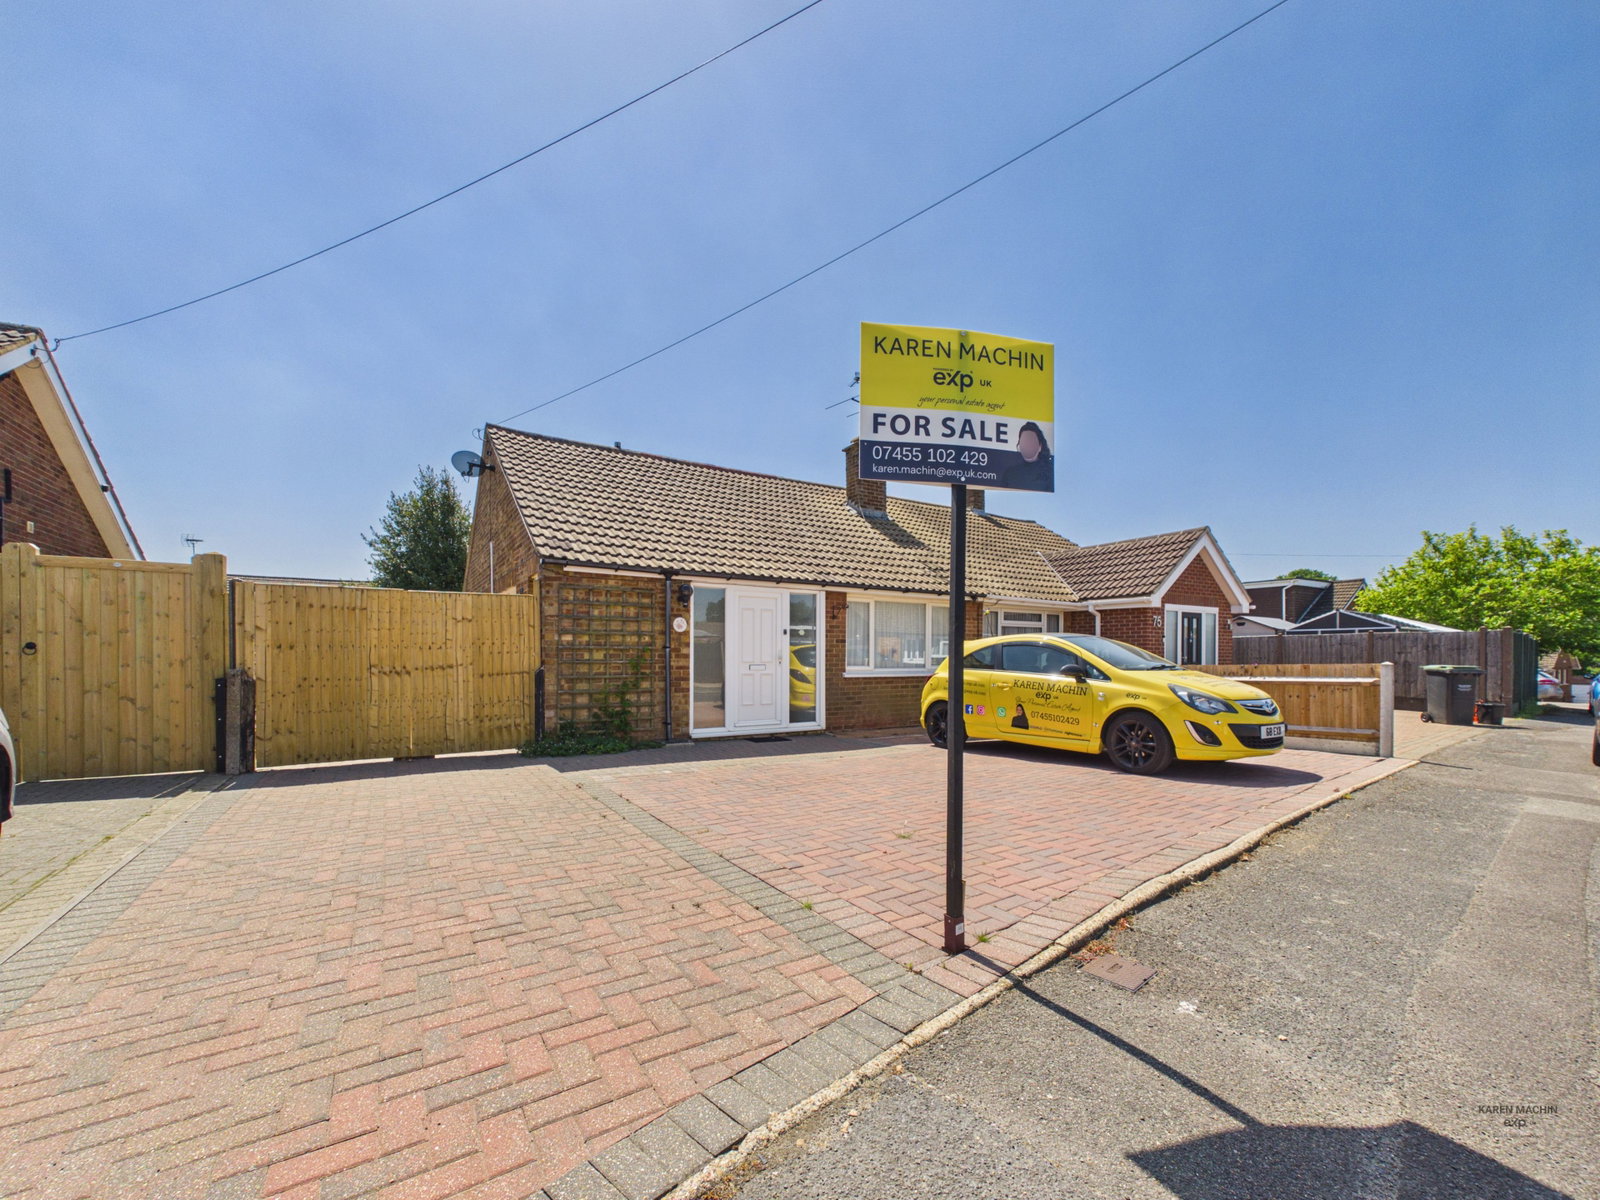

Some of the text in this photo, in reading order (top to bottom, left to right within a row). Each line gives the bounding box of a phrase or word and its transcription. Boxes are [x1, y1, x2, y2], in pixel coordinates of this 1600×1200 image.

[874, 336, 1044, 371] KAREN MACHIN
[979, 379, 992, 387] UK
[917, 395, 1005, 412] your personal estate agent
[872, 413, 1009, 444] FOR SALE
[872, 446, 988, 466] 07455 102 429
[1013, 679, 1088, 696] KAREN MACHIN
[1031, 711, 1080, 726] 07455102429
